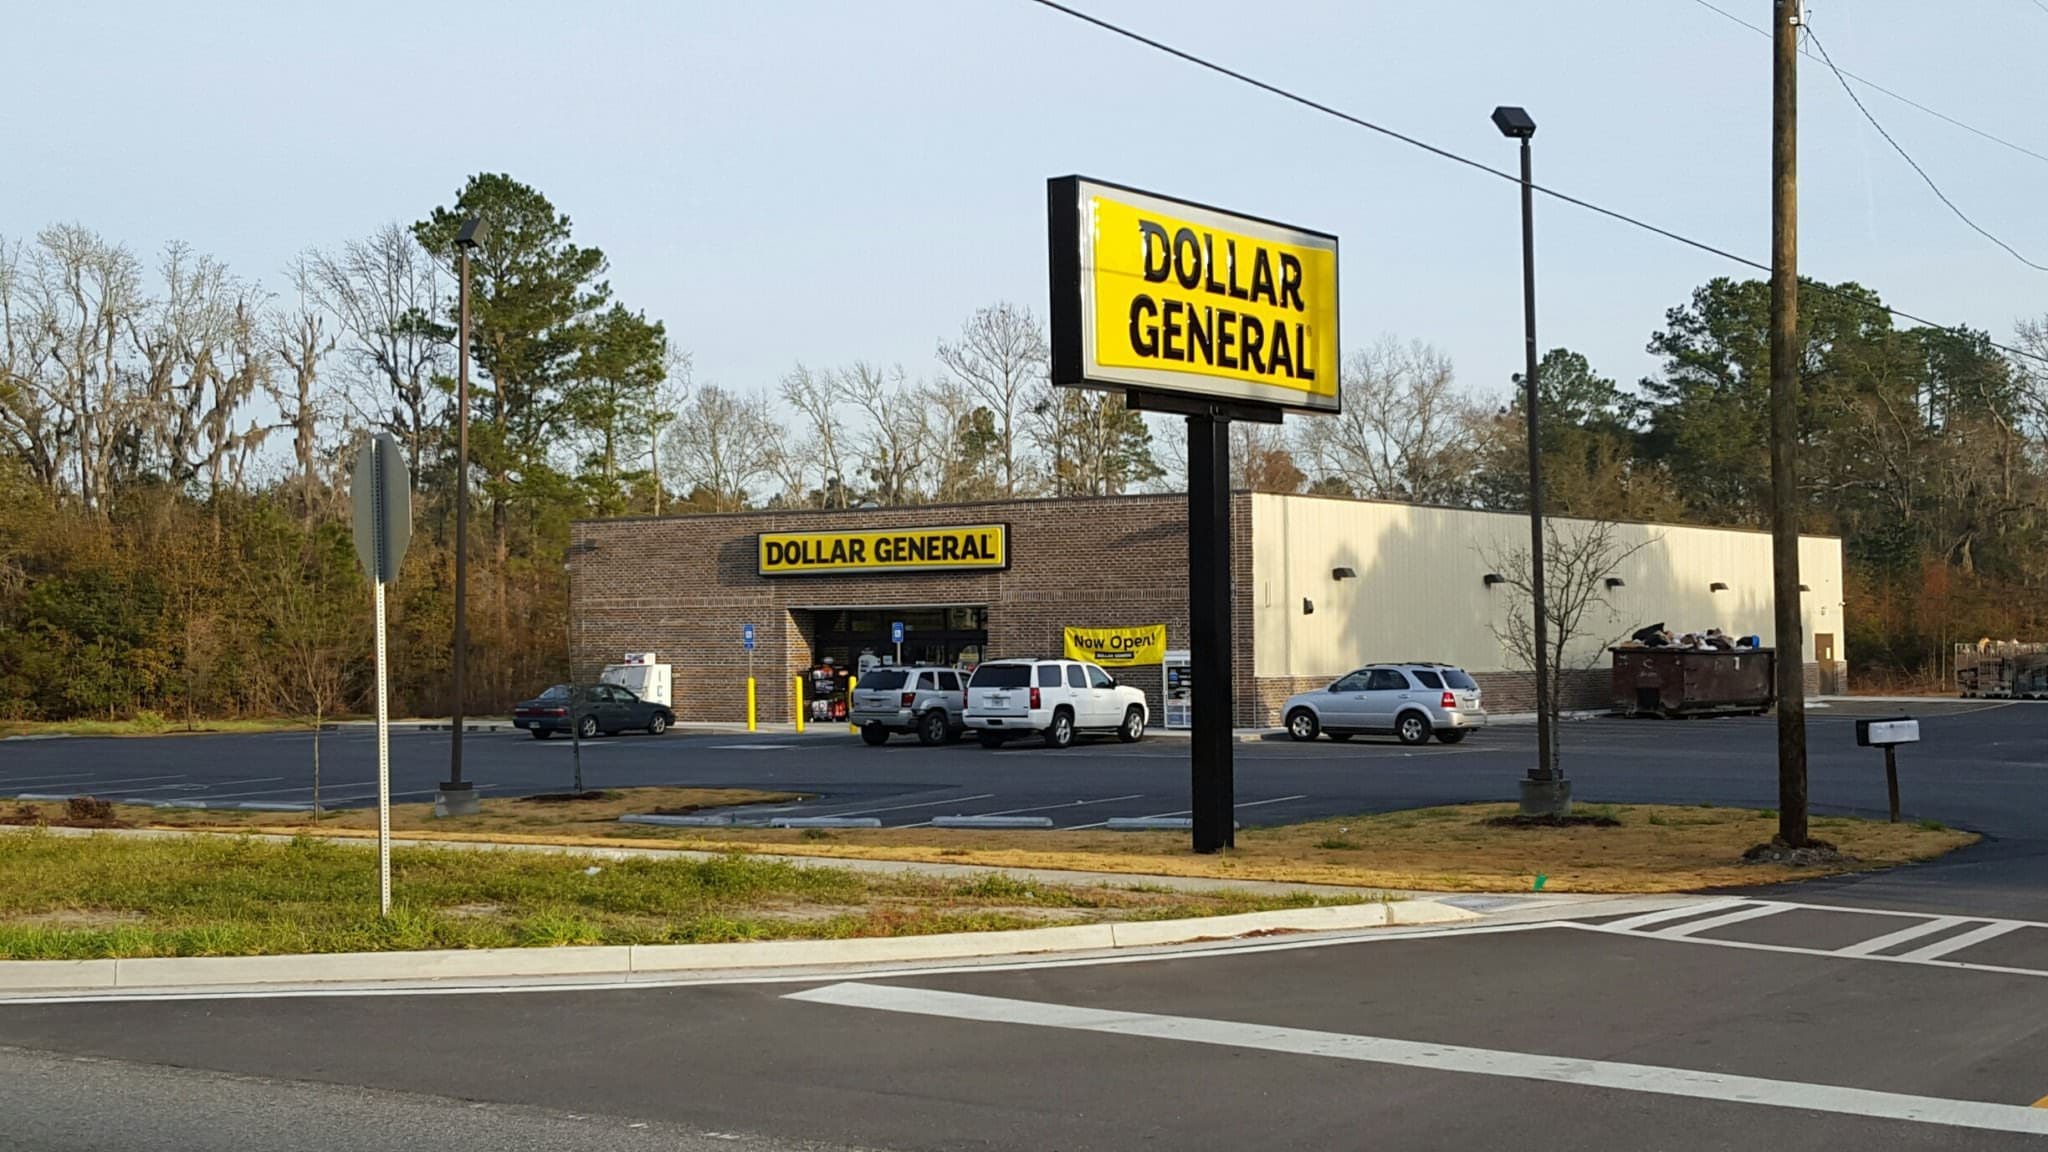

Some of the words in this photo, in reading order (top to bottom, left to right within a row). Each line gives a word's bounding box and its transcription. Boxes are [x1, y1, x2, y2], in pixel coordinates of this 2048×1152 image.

[1138, 219, 1305, 312] DOLLAR
[1128, 293, 1315, 381] GENERAL
[765, 538, 866, 566] DOLLAR
[874, 534, 996, 562] GENERAL
[1074, 634, 1105, 649] Now
[1110, 632, 1155, 651] Open!
[656, 670, 664, 703] IC
